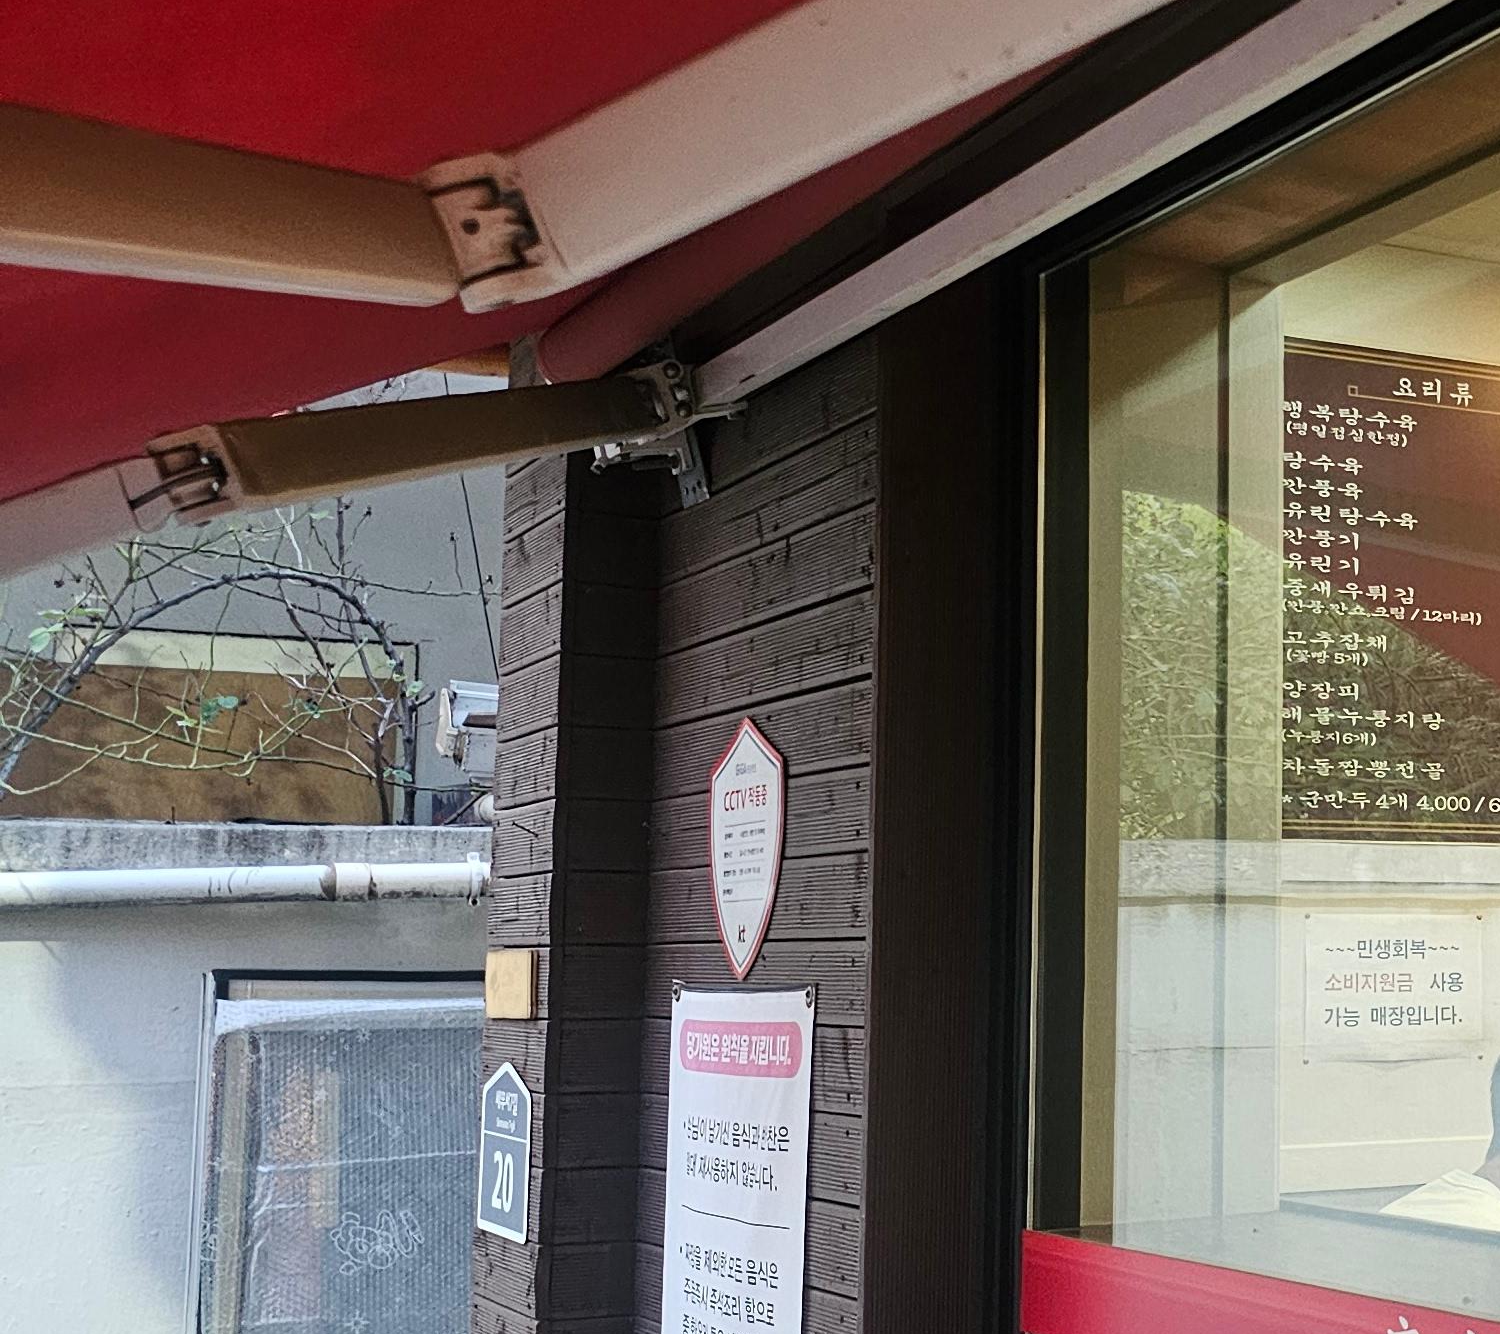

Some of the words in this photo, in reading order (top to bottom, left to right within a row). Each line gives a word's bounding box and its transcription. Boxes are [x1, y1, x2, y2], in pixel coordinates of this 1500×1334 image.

[1393, 378, 1473, 407] 요리류
[1282, 400, 1417, 432] 행복탕수육
[1282, 451, 1363, 475] 탕수육
[1282, 477, 1363, 501] 깐풍육
[1282, 502, 1418, 531] 유린탕수육
[1282, 527, 1359, 551] 깐풍기
[1282, 552, 1359, 576] 유린기
[1282, 578, 1415, 605] 중새우튀김
[1423, 609, 1482, 626] 12마리)
[1282, 631, 1387, 651] 고추잡채
[1334, 652, 1369, 666] 5개)
[1282, 680, 1359, 701] 양장피
[1281, 707, 1445, 731] 해물누룽지탕
[1282, 730, 1377, 746] (누룽지6개)
[1282, 757, 1445, 780] 차돌짬뽕전골
[724, 789, 747, 811] CCTV
[748, 784, 767, 807] 작동중
[1300, 791, 1371, 809] 군만두
[1376, 794, 1408, 811] 4개
[1416, 795, 1471, 812] 4,000
[738, 925, 746, 943] kt
[1324, 973, 1414, 993] 소비지원금
[1430, 972, 1464, 992] 사용
[1324, 1006, 1360, 1027] 가능
[1370, 1005, 1463, 1027] 매장입니다.
[686, 1032, 720, 1063] 당가원은
[722, 1034, 749, 1064] 원칙을
[750, 1035, 792, 1065] 지킵니다.
[492, 1151, 514, 1213] 20
[746, 1259, 779, 1289] 음식은
[745, 1297, 775, 1327] 함으로
